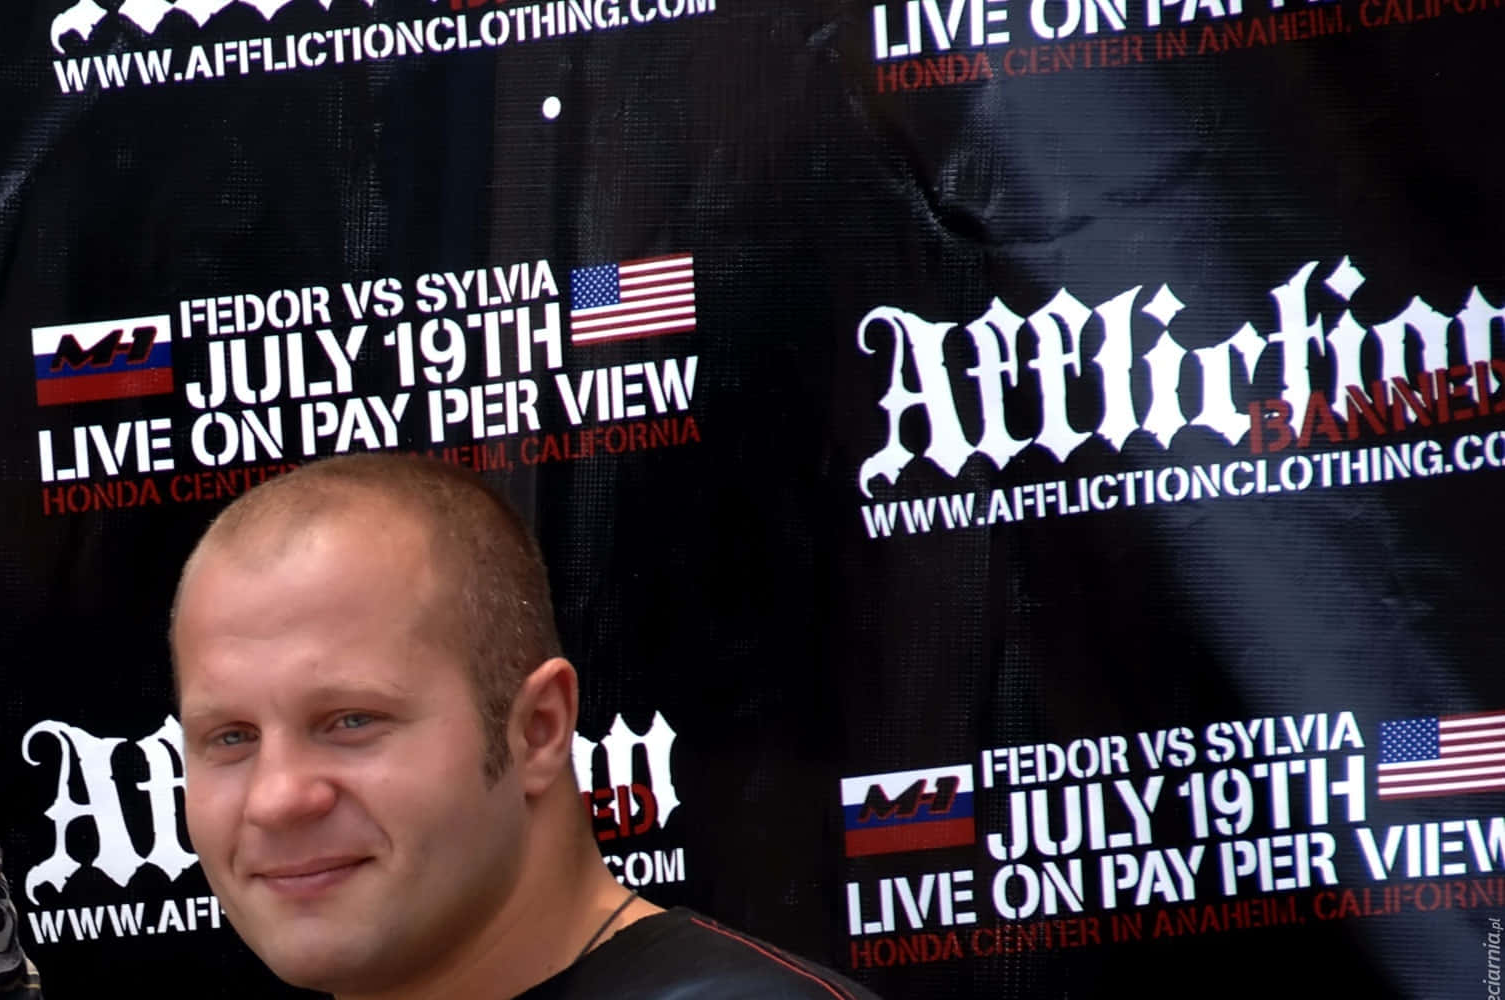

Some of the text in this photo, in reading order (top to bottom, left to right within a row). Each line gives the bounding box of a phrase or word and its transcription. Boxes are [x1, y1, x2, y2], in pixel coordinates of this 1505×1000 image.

[873, 4, 1009, 60] LIVE
[1030, 0, 1128, 40] ON
[875, 55, 993, 95] HONDA
[1003, 37, 1143, 76] CENTER
[1155, 30, 1188, 60] IN
[180, 259, 558, 338] FEDOR VS SYLVIA
[185, 303, 562, 409] JULY 19TH
[38, 355, 699, 482] LIVE ON PAY PER VIEW
[1249, 360, 1505, 455] BANNED
[42, 476, 162, 516] HONDA
[520, 416, 702, 466] CALIFORNIA
[862, 432, 1505, 538] WWW.AFFLICTIONCLOTHING.CO
[981, 711, 1364, 788] FEDOR VS SYLVIA
[987, 755, 1367, 861] JULY 19TH
[847, 816, 1505, 936] LIVE ON PAY PER VIEW
[850, 937, 964, 970] HONDA
[970, 919, 1102, 958] CENTER
[1111, 913, 1143, 942] IN
[1313, 876, 1505, 921] CALIFORNI
